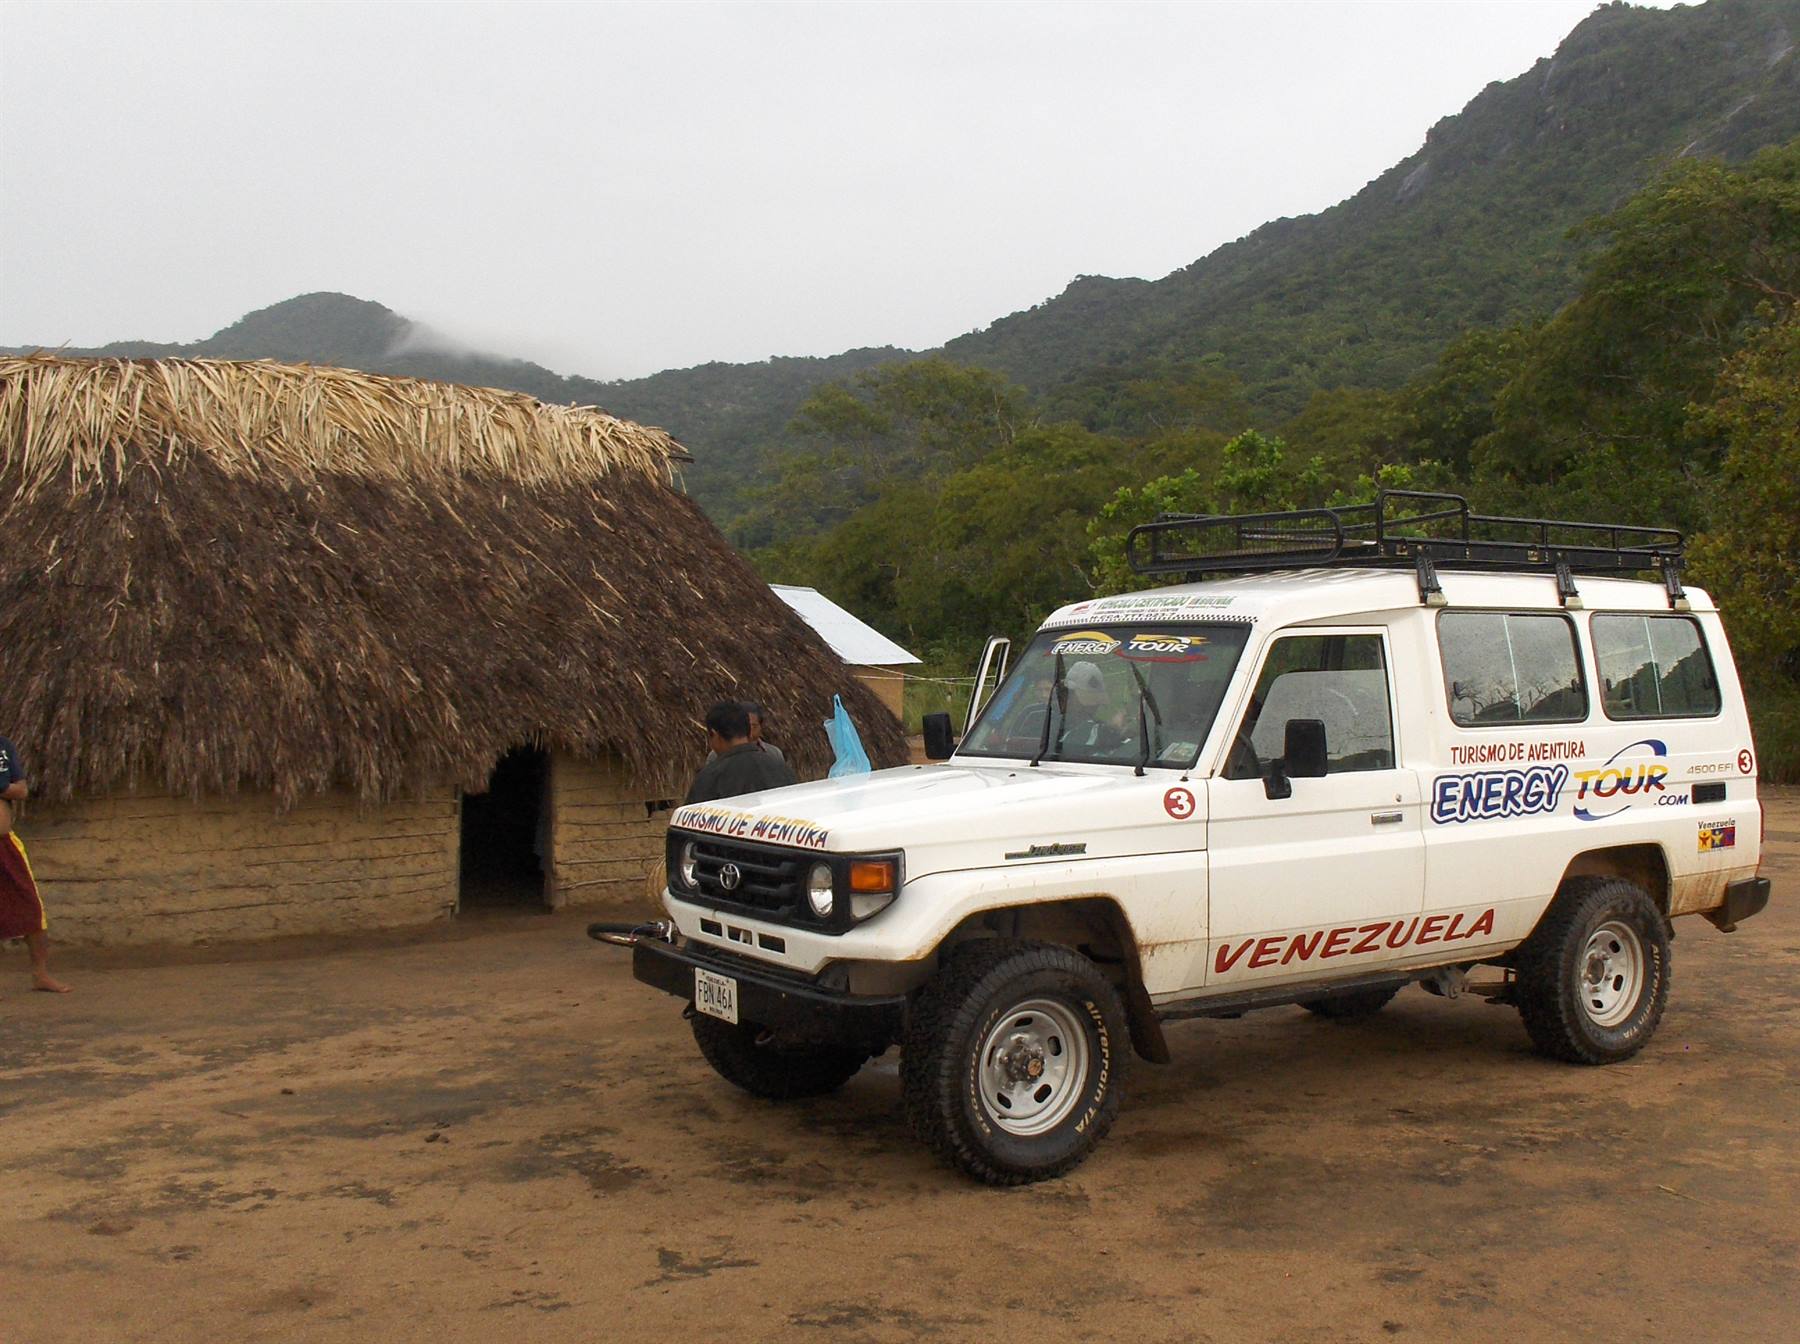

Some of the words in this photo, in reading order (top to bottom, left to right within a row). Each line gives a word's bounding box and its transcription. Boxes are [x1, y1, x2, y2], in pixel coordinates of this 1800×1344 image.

[1052, 640, 1121, 654] ENERGY
[1129, 641, 1189, 653] TOUR
[1451, 743, 1506, 764] TURISMO
[1509, 742, 1525, 760] DE
[1528, 740, 1586, 761] AVENTURA
[1687, 764, 1716, 774] 4500
[1717, 763, 1734, 772] EFI
[1169, 790, 1190, 815] 3
[1431, 764, 1568, 823] ENERGY
[1574, 764, 1669, 799] TOUR
[675, 808, 731, 832] TURISMO
[728, 812, 753, 835] DE
[751, 815, 832, 848] AVENTURA
[1698, 818, 1735, 829] Venezuela
[1214, 908, 1495, 973] VENEZUELA
[698, 979, 715, 1005] FBN
[716, 986, 733, 1011] 46A
[1074, 1106, 1097, 1134] T/A
